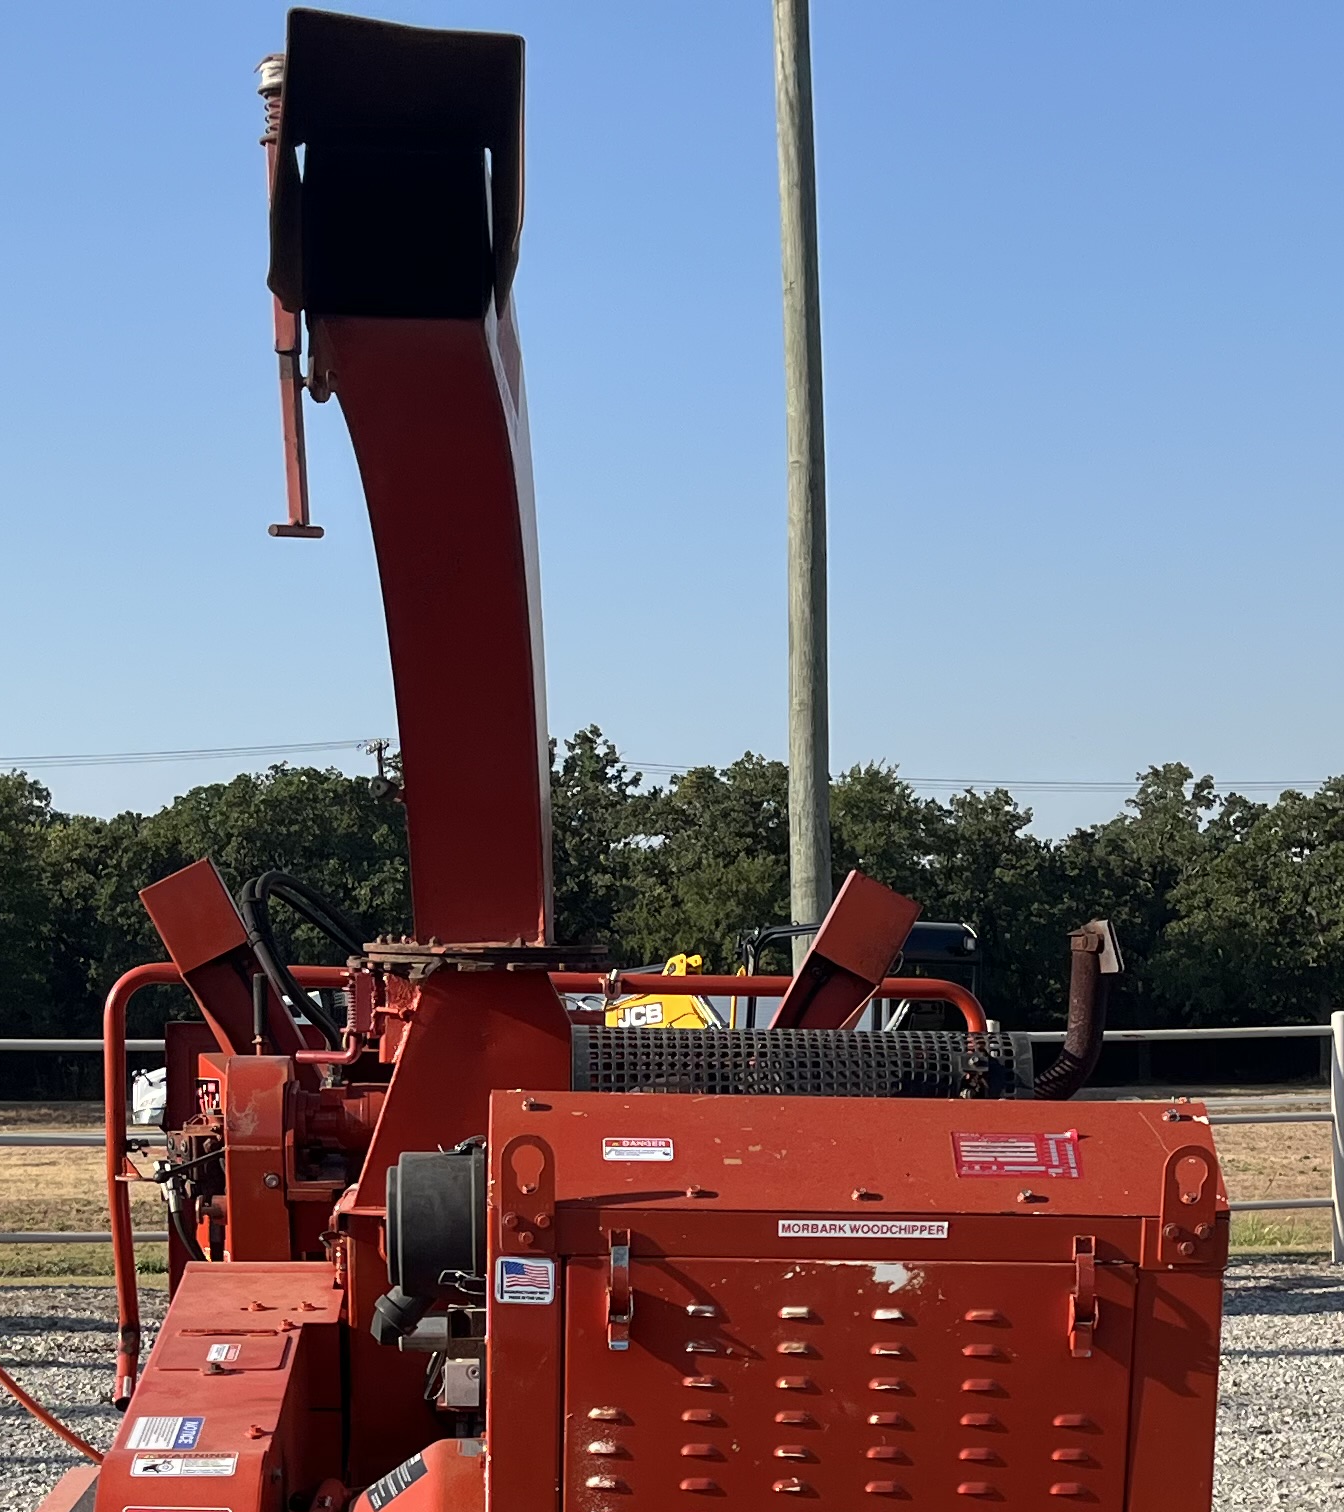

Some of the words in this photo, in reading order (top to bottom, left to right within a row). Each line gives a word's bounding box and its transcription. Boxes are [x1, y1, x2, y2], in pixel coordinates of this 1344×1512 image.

[617, 1002, 663, 1028] JCB
[781, 1223, 847, 1234] MORBARK
[849, 1224, 945, 1236] WOODCHIPPER
[177, 1421, 200, 1444] NOTICE
